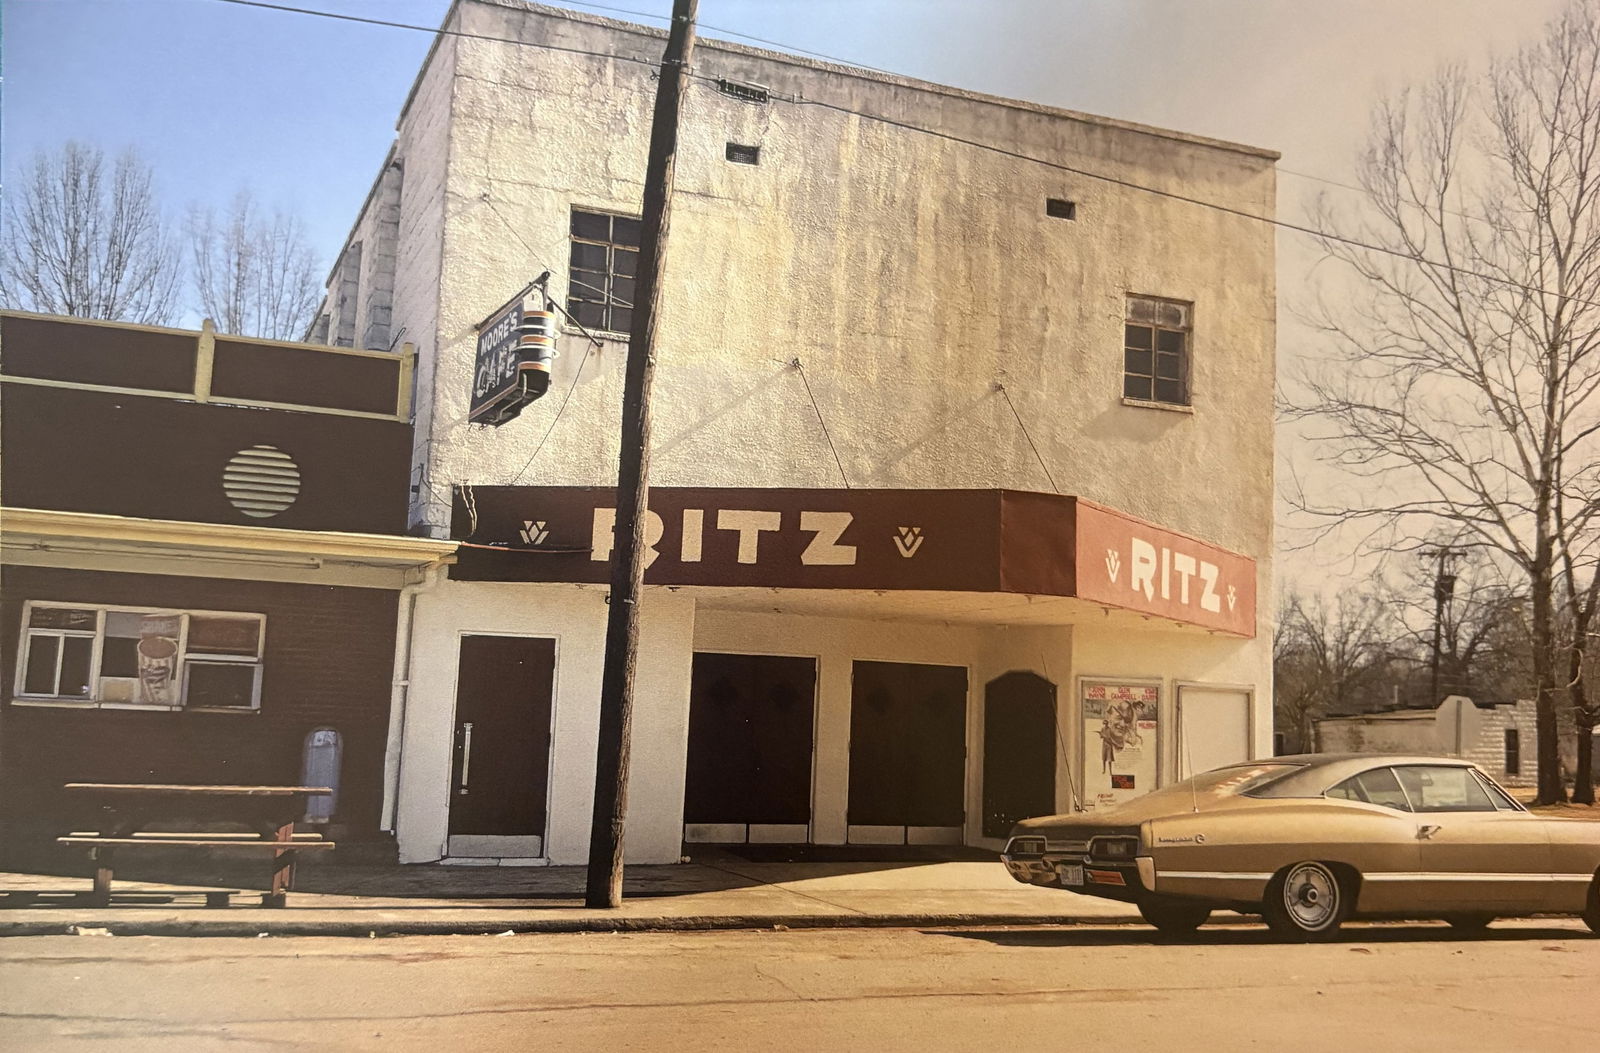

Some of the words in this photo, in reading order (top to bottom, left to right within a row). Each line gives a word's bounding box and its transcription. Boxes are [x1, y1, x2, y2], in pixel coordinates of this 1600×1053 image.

[480, 310, 518, 356] MOORE'S
[591, 508, 857, 570] RITZ
[1131, 537, 1220, 613] RITZ
